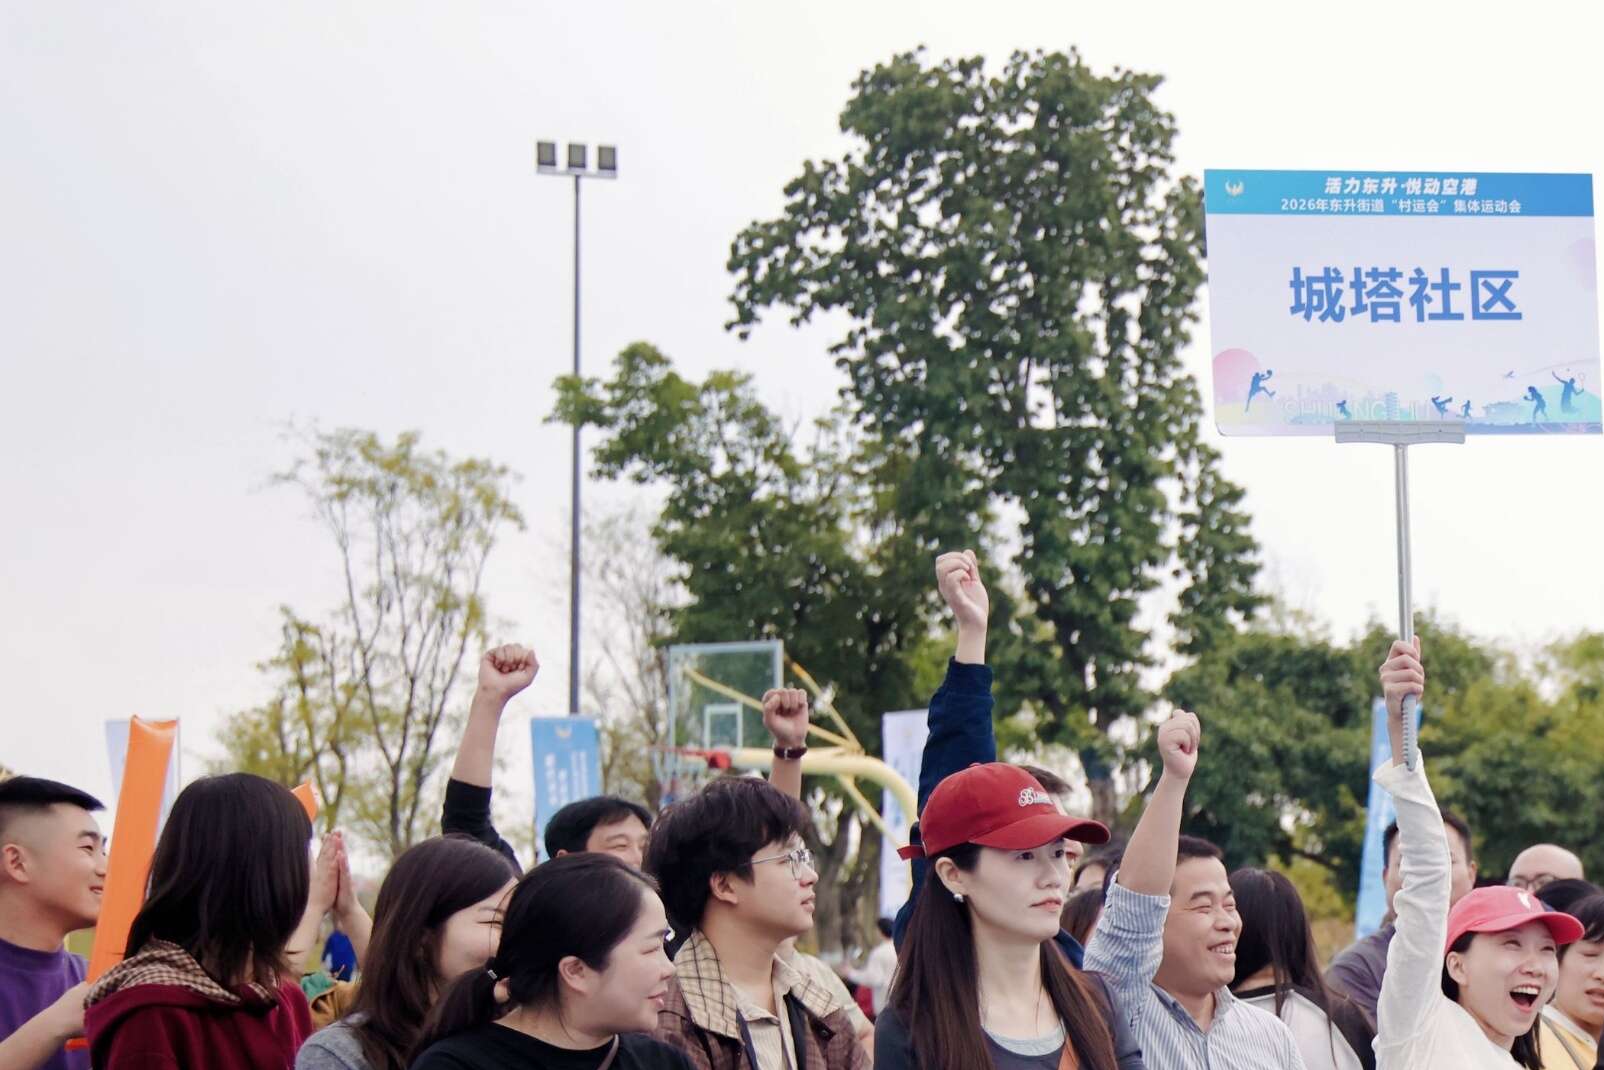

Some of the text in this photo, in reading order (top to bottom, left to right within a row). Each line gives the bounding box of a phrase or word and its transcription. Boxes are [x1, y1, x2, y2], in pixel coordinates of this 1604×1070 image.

[1324, 176, 1478, 196] 活力东升·悦动空港
[1289, 266, 1523, 323] 城塔社区
